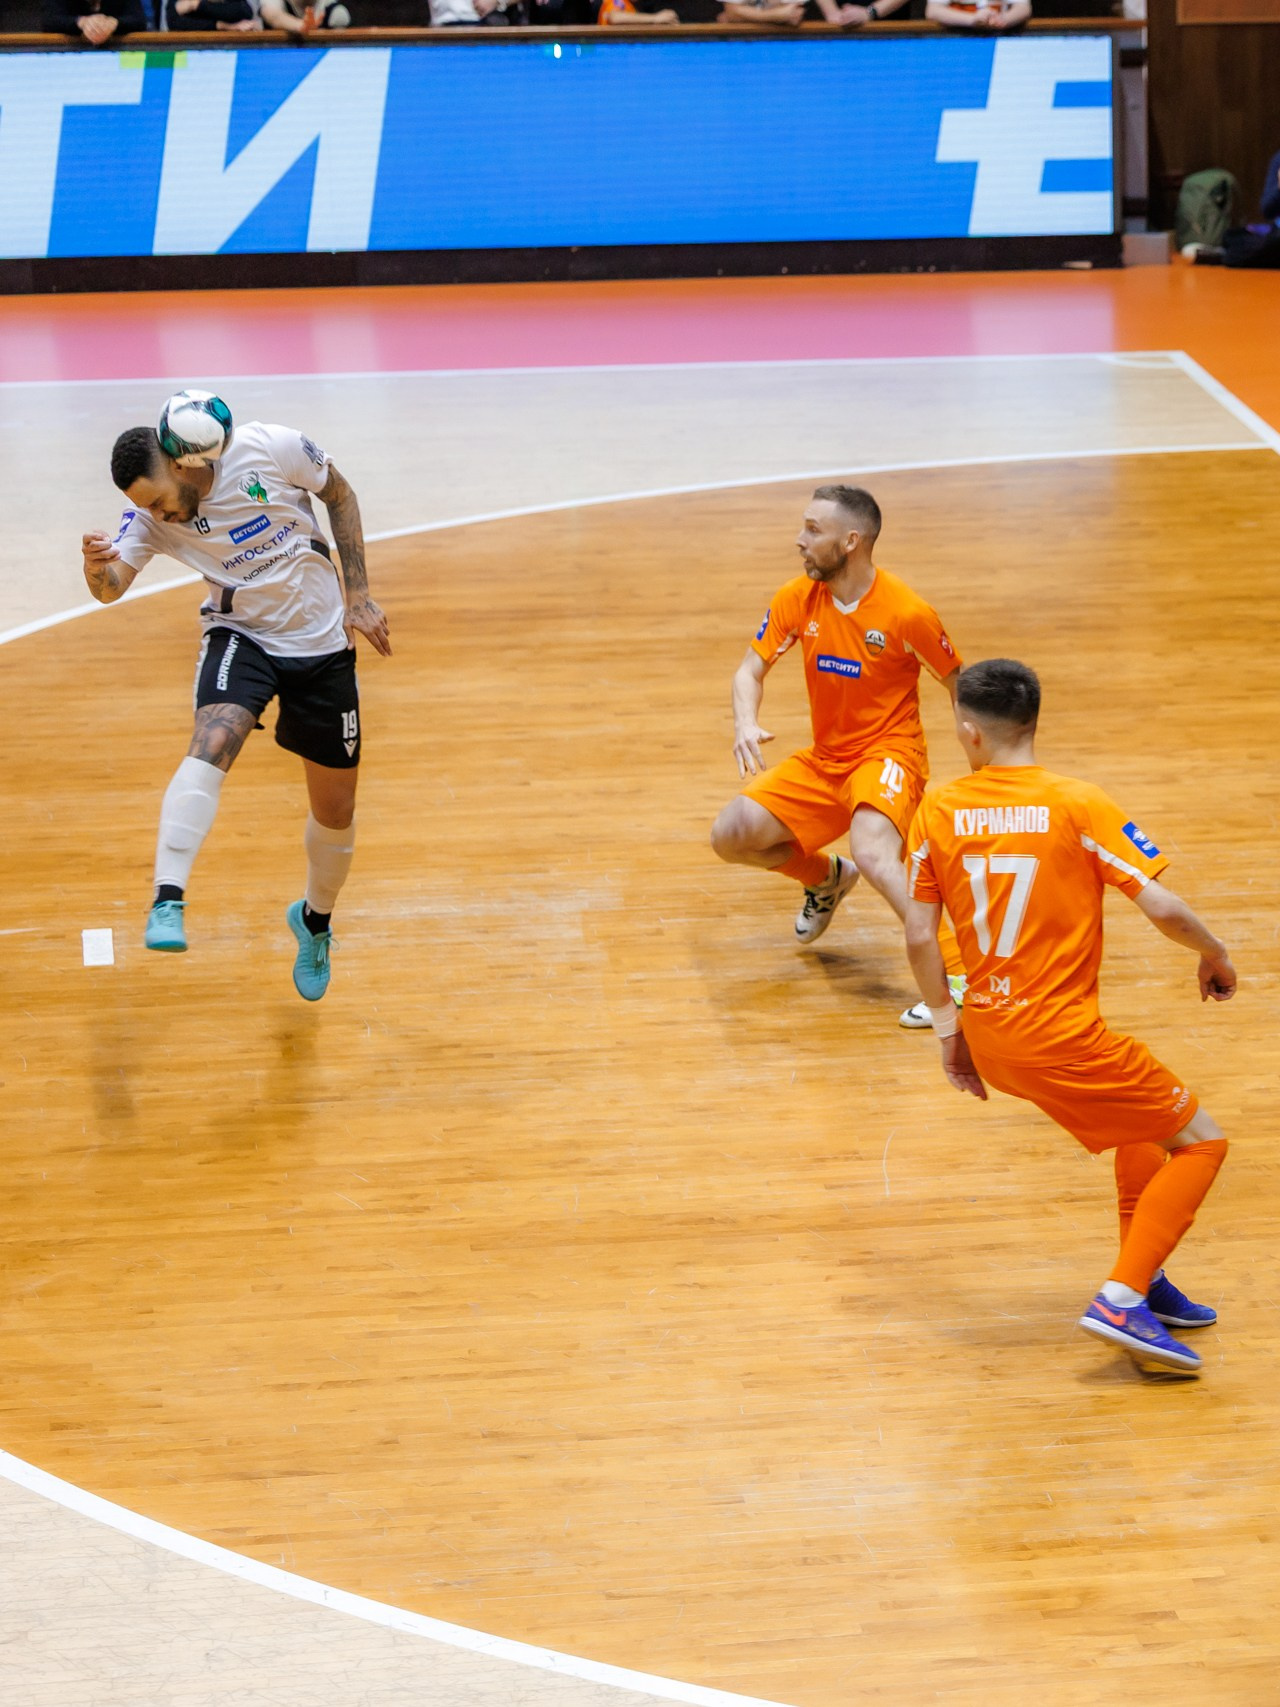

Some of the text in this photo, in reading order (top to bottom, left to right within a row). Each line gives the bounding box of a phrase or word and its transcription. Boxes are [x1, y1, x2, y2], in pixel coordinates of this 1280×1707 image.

[194, 516, 211, 535] 19
[221, 520, 300, 571] ИНГОССТРАХ
[216, 636, 240, 691] CORDIANT
[341, 709, 358, 739] 19
[879, 756, 906, 794] 10
[954, 805, 1050, 836] КУРМАНОВ
[962, 853, 1041, 958] 17
